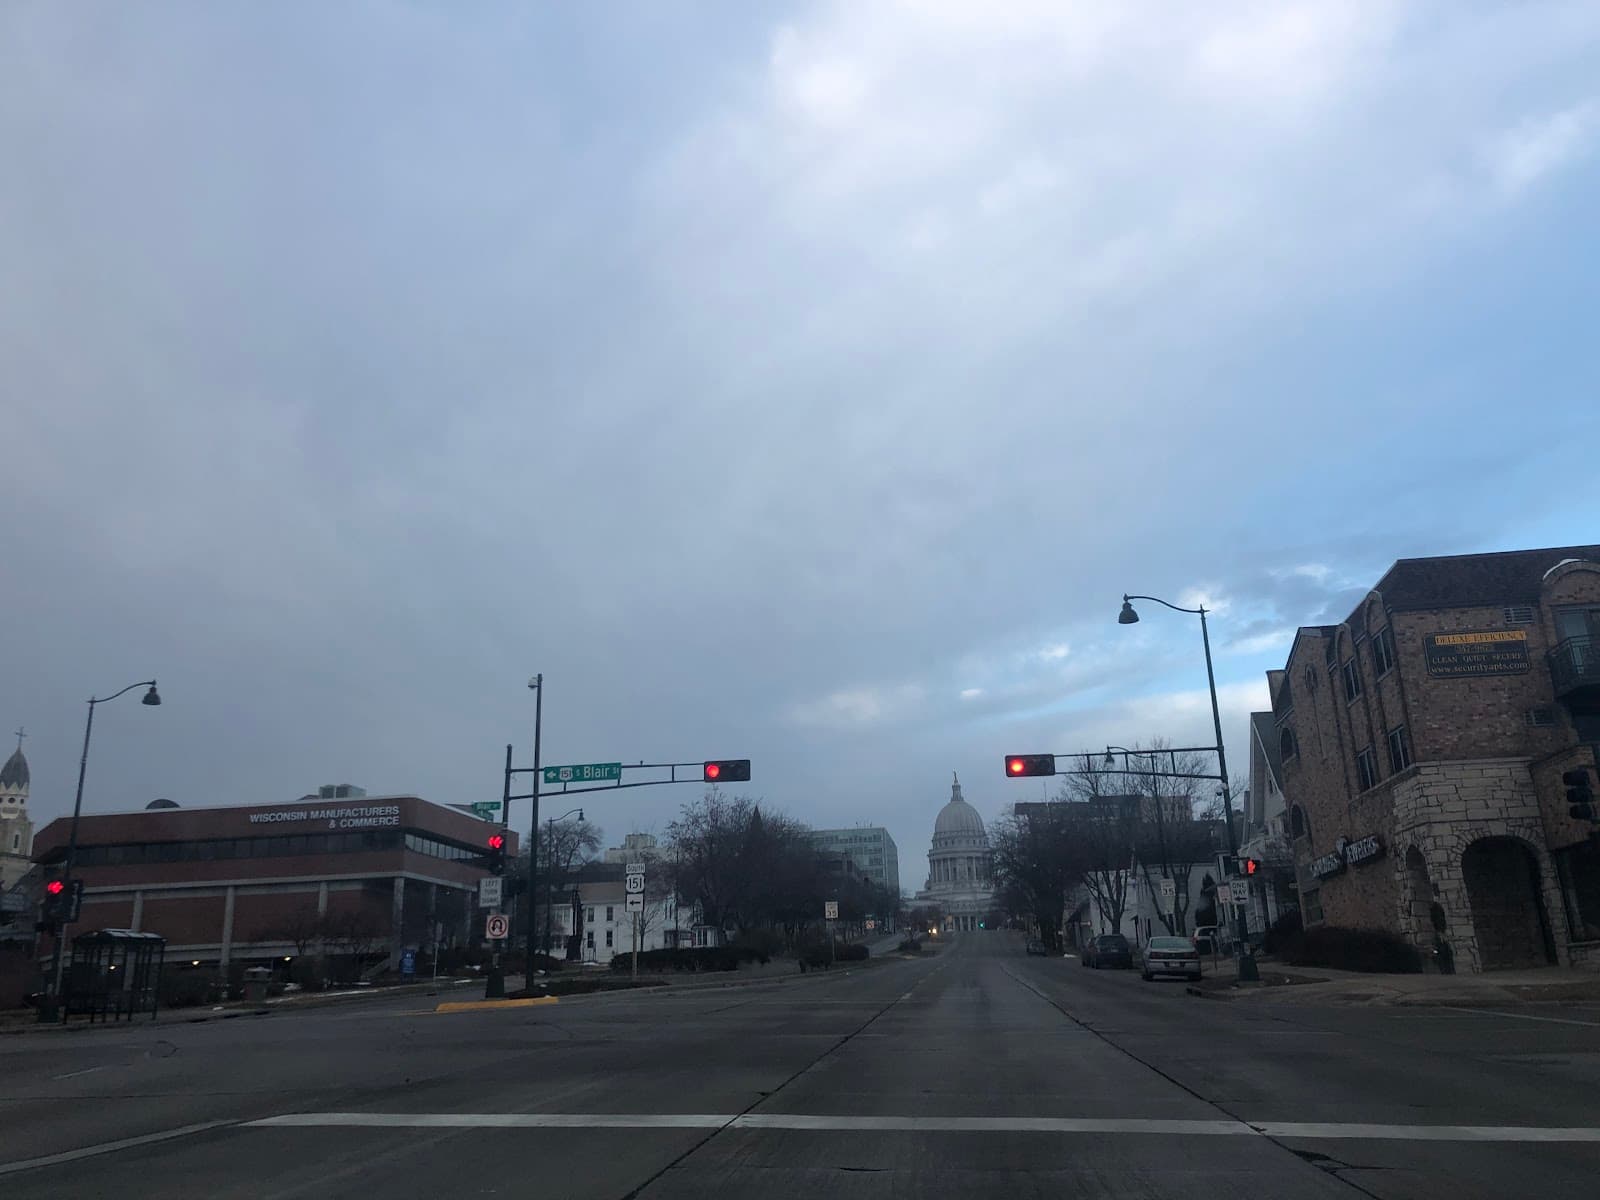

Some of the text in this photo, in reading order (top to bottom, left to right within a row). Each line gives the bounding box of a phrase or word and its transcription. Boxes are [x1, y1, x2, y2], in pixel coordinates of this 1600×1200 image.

[583, 766, 609, 778] Blair
[249, 806, 399, 823] WISCONSIN MANUFACTURERS
[329, 816, 399, 829] & COMMERCE
[628, 864, 645, 872] SOUTH
[629, 878, 642, 889] 151
